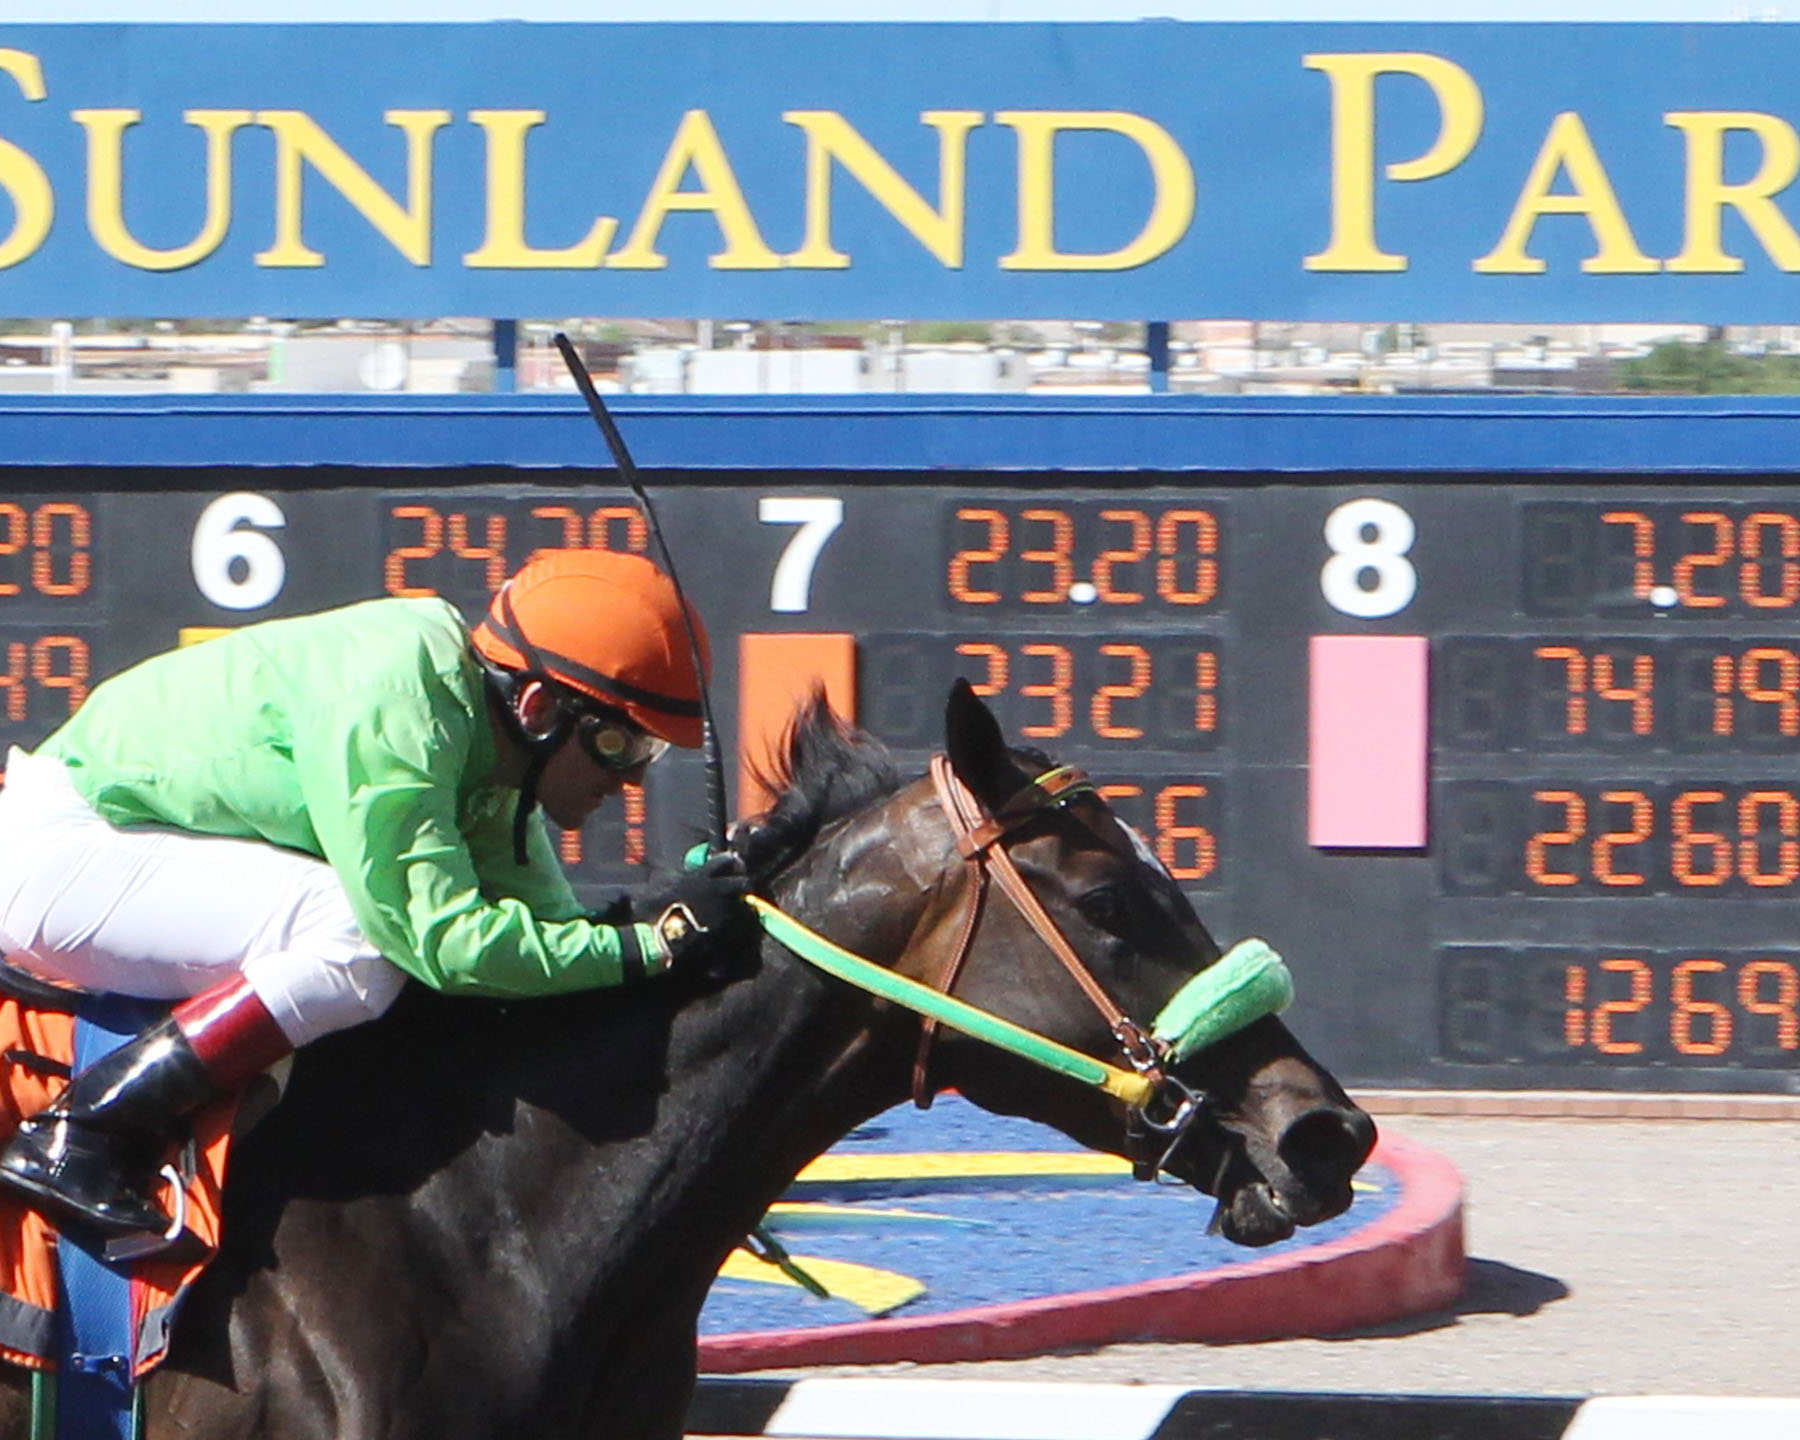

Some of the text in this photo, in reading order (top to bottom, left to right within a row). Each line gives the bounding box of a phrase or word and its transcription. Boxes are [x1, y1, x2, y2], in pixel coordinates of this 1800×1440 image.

[192, 492, 285, 609] 6
[759, 498, 844, 612] 7
[949, 510, 1219, 605] 23.20
[1321, 499, 1417, 618] 8
[1603, 512, 1800, 610] 7.20
[1535, 647, 1800, 737] 7419
[1526, 791, 1800, 888] 2260
[1566, 959, 1800, 1057] 1269
